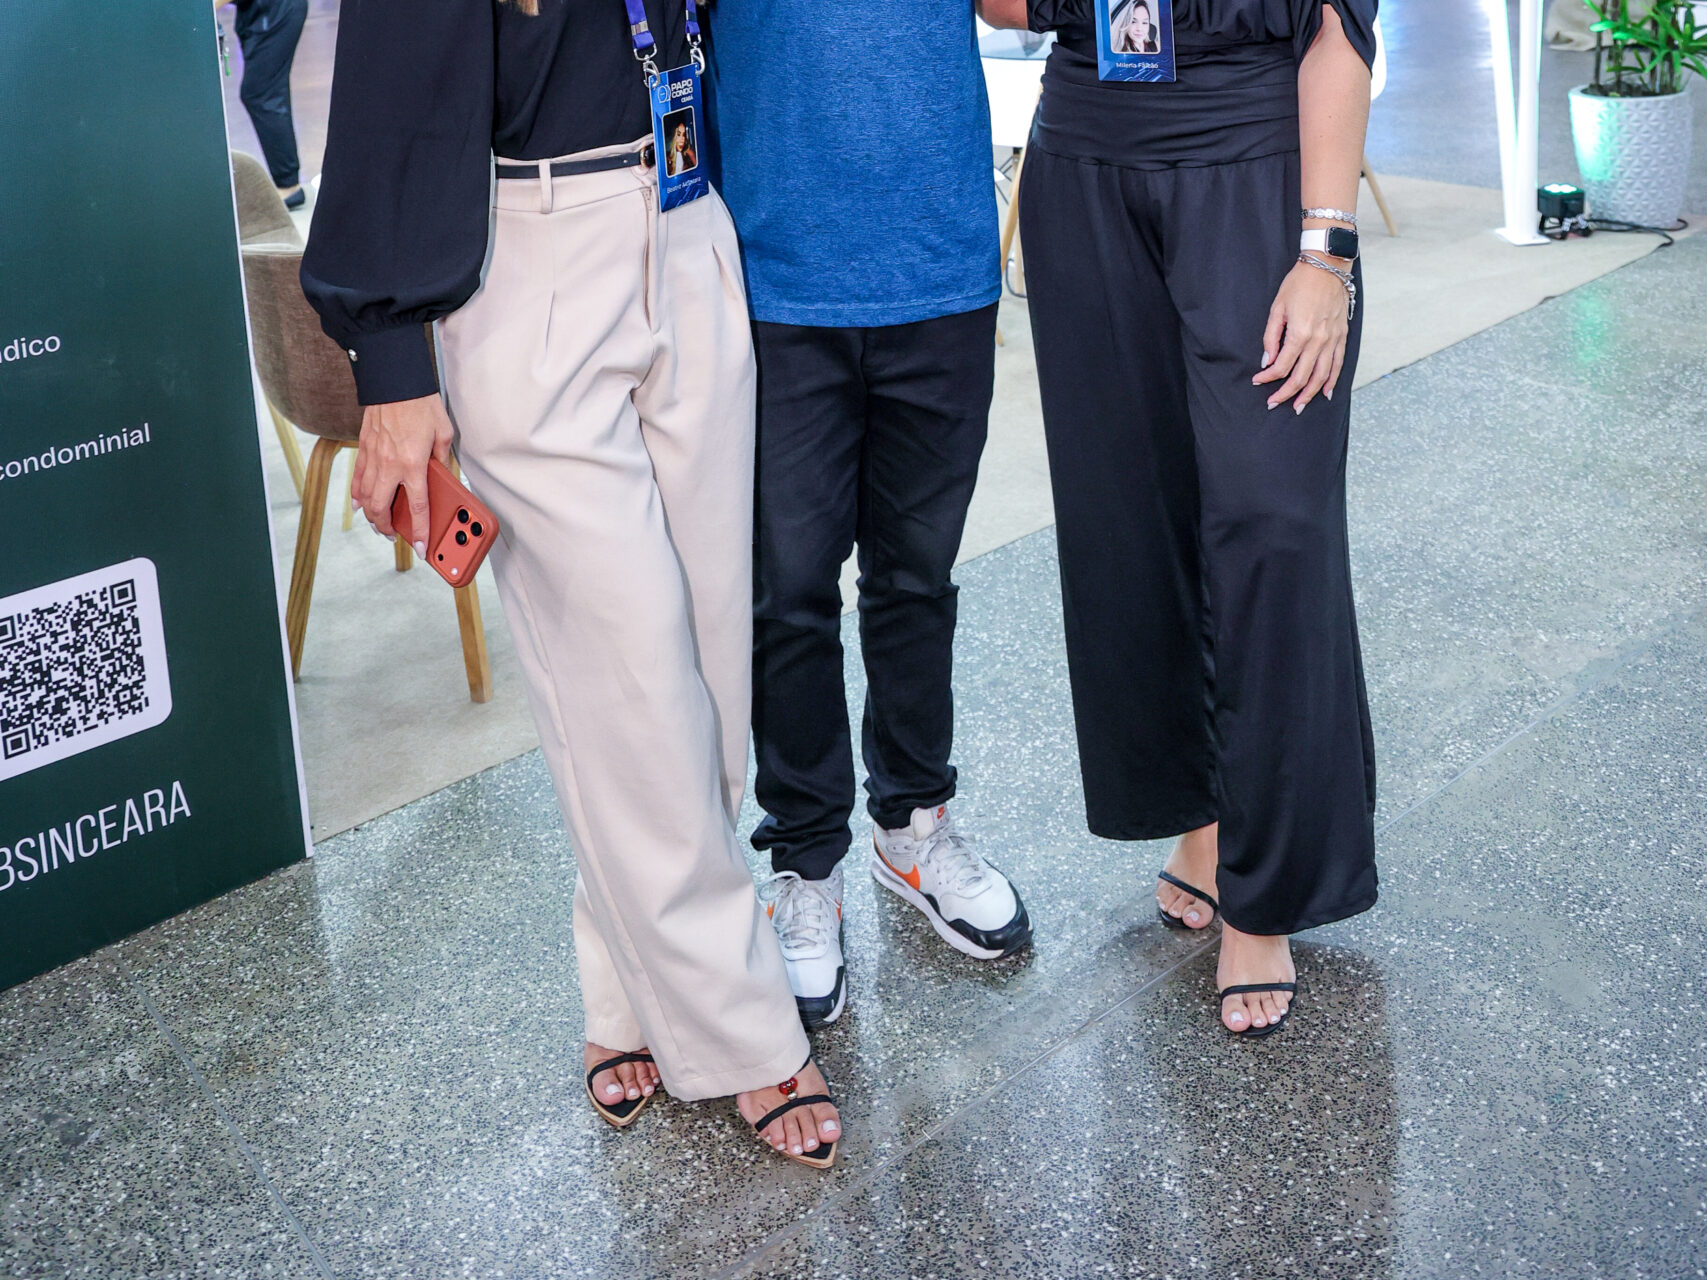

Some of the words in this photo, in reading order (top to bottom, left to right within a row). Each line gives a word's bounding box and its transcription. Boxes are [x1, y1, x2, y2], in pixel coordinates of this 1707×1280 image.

[671, 78, 693, 91] PAPO
[671, 86, 694, 99] CONDO
[0, 336, 61, 364] dico
